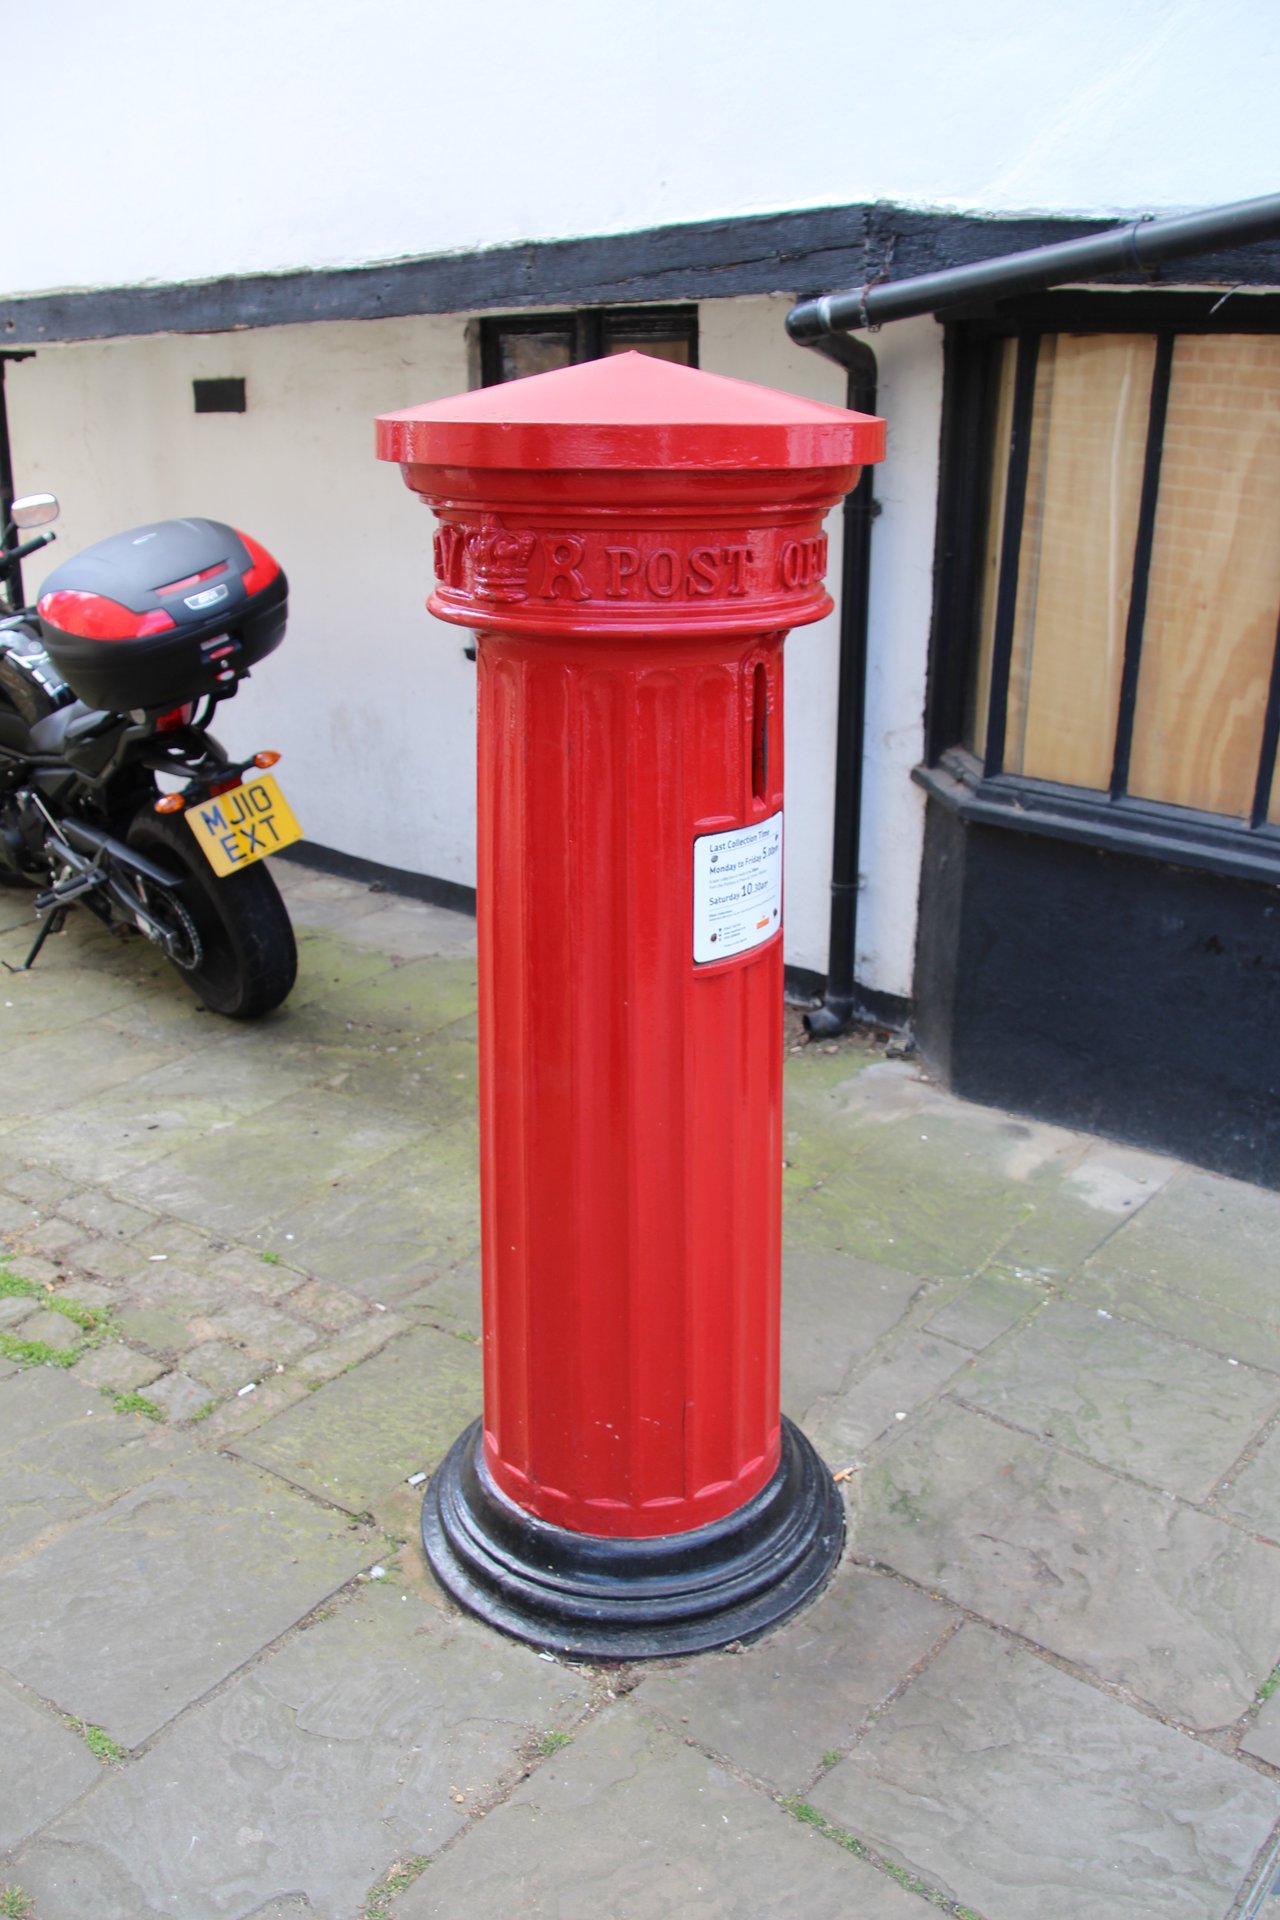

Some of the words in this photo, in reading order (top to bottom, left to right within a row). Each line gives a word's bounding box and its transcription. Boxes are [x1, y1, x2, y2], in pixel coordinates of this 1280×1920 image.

[539, 534, 592, 601] R
[604, 546, 755, 598] POST
[200, 785, 272, 836] MJ10
[220, 814, 280, 863] EXT
[709, 843, 726, 853] Last
[727, 835, 758, 849] Collection
[709, 864, 737, 875] Monday
[745, 855, 762, 865] Friday
[709, 893, 740, 906] Saturday
